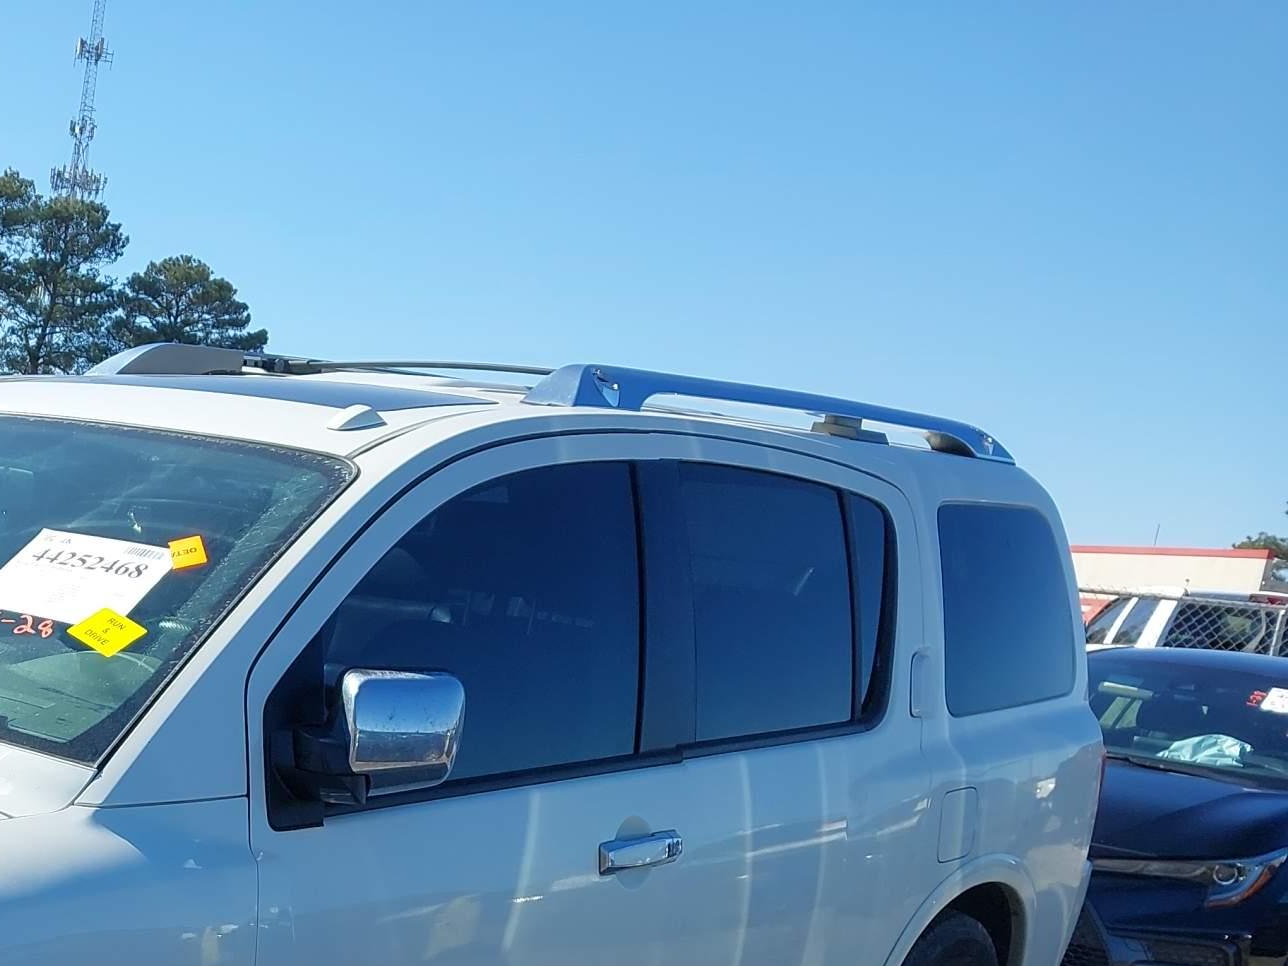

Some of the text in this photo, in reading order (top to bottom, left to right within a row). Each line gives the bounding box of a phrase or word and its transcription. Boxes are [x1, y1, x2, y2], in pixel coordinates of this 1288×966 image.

[31, 547, 149, 579] 44252468
[107, 617, 127, 631] RUN
[84, 628, 110, 646] DRIVE
